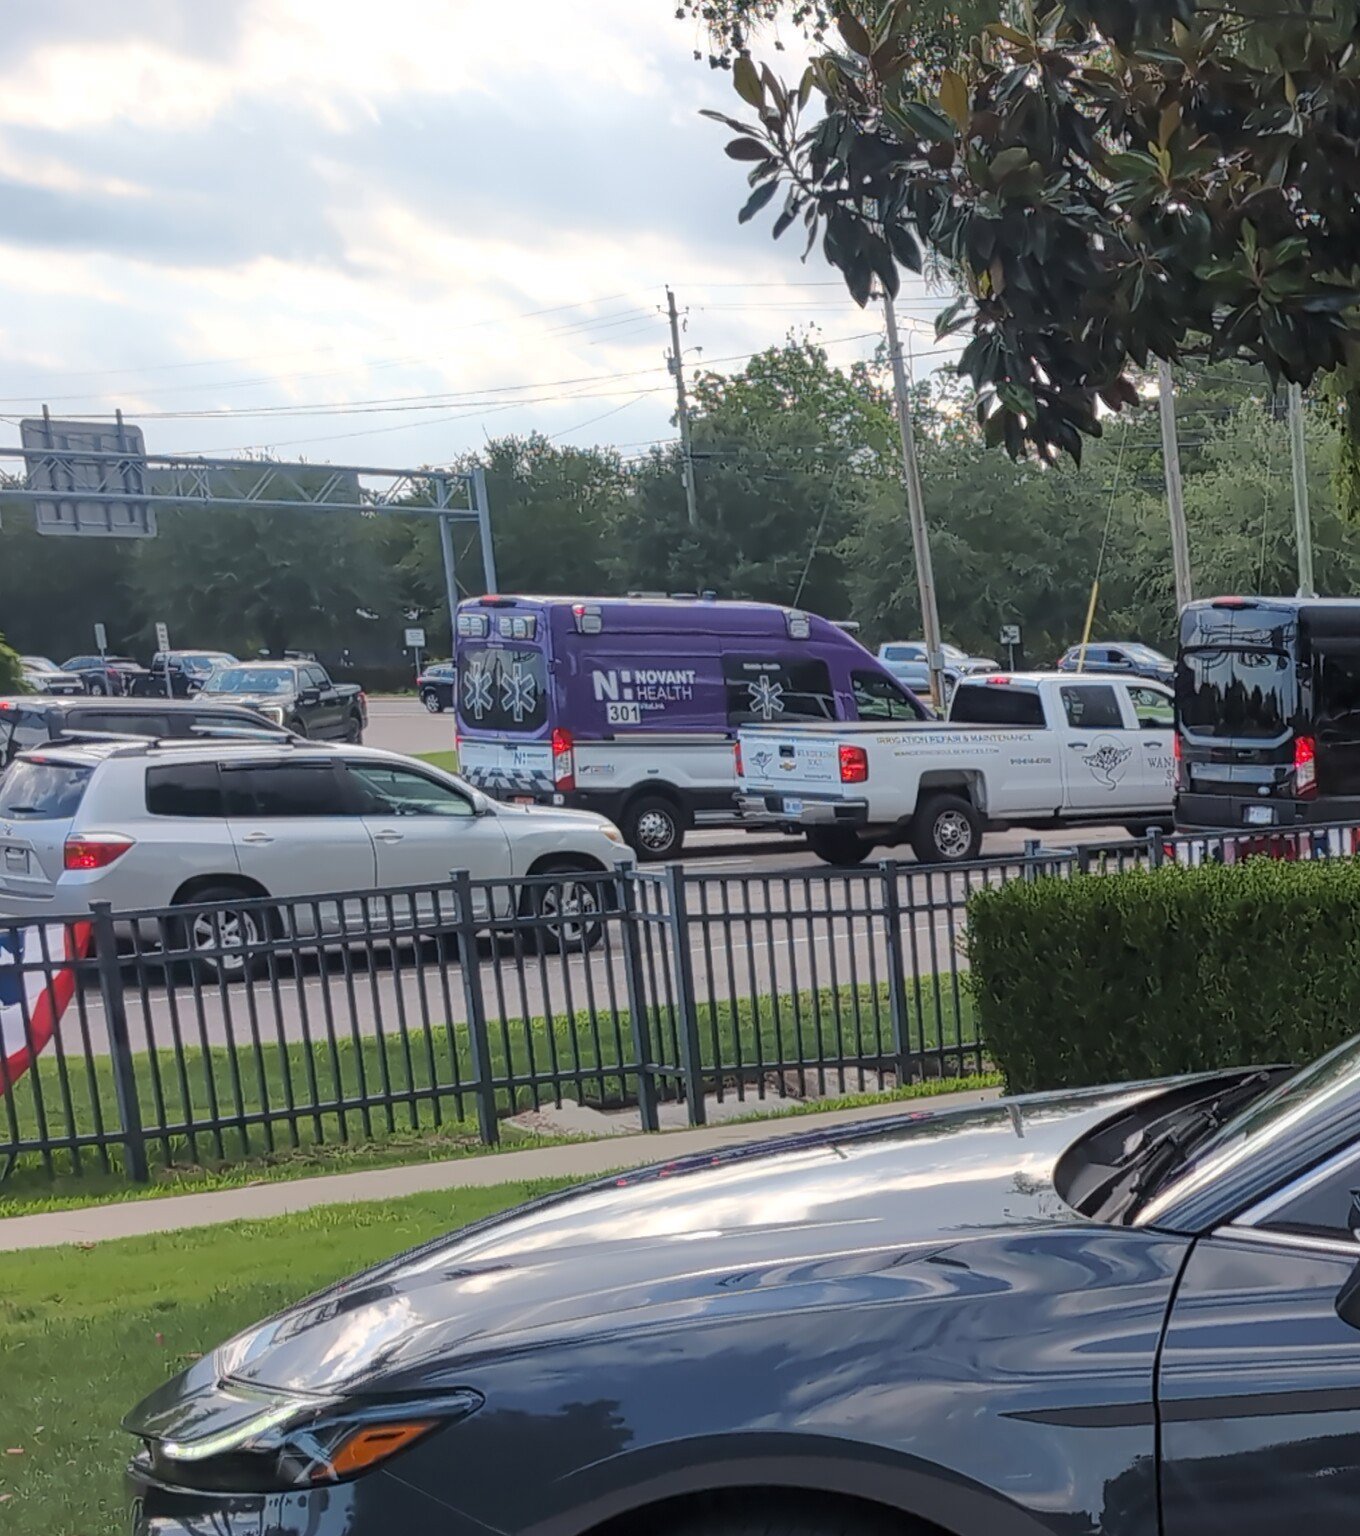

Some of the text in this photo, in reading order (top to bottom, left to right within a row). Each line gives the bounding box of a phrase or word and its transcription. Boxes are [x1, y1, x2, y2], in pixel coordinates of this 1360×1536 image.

[634, 670, 696, 684] NOVANT
[637, 686, 693, 700] HEALTH
[610, 705, 639, 721] 301
[876, 735, 928, 744] IRRIGATION
[929, 735, 961, 743] REPAIR
[970, 734, 1033, 743] MAINTENANCE
